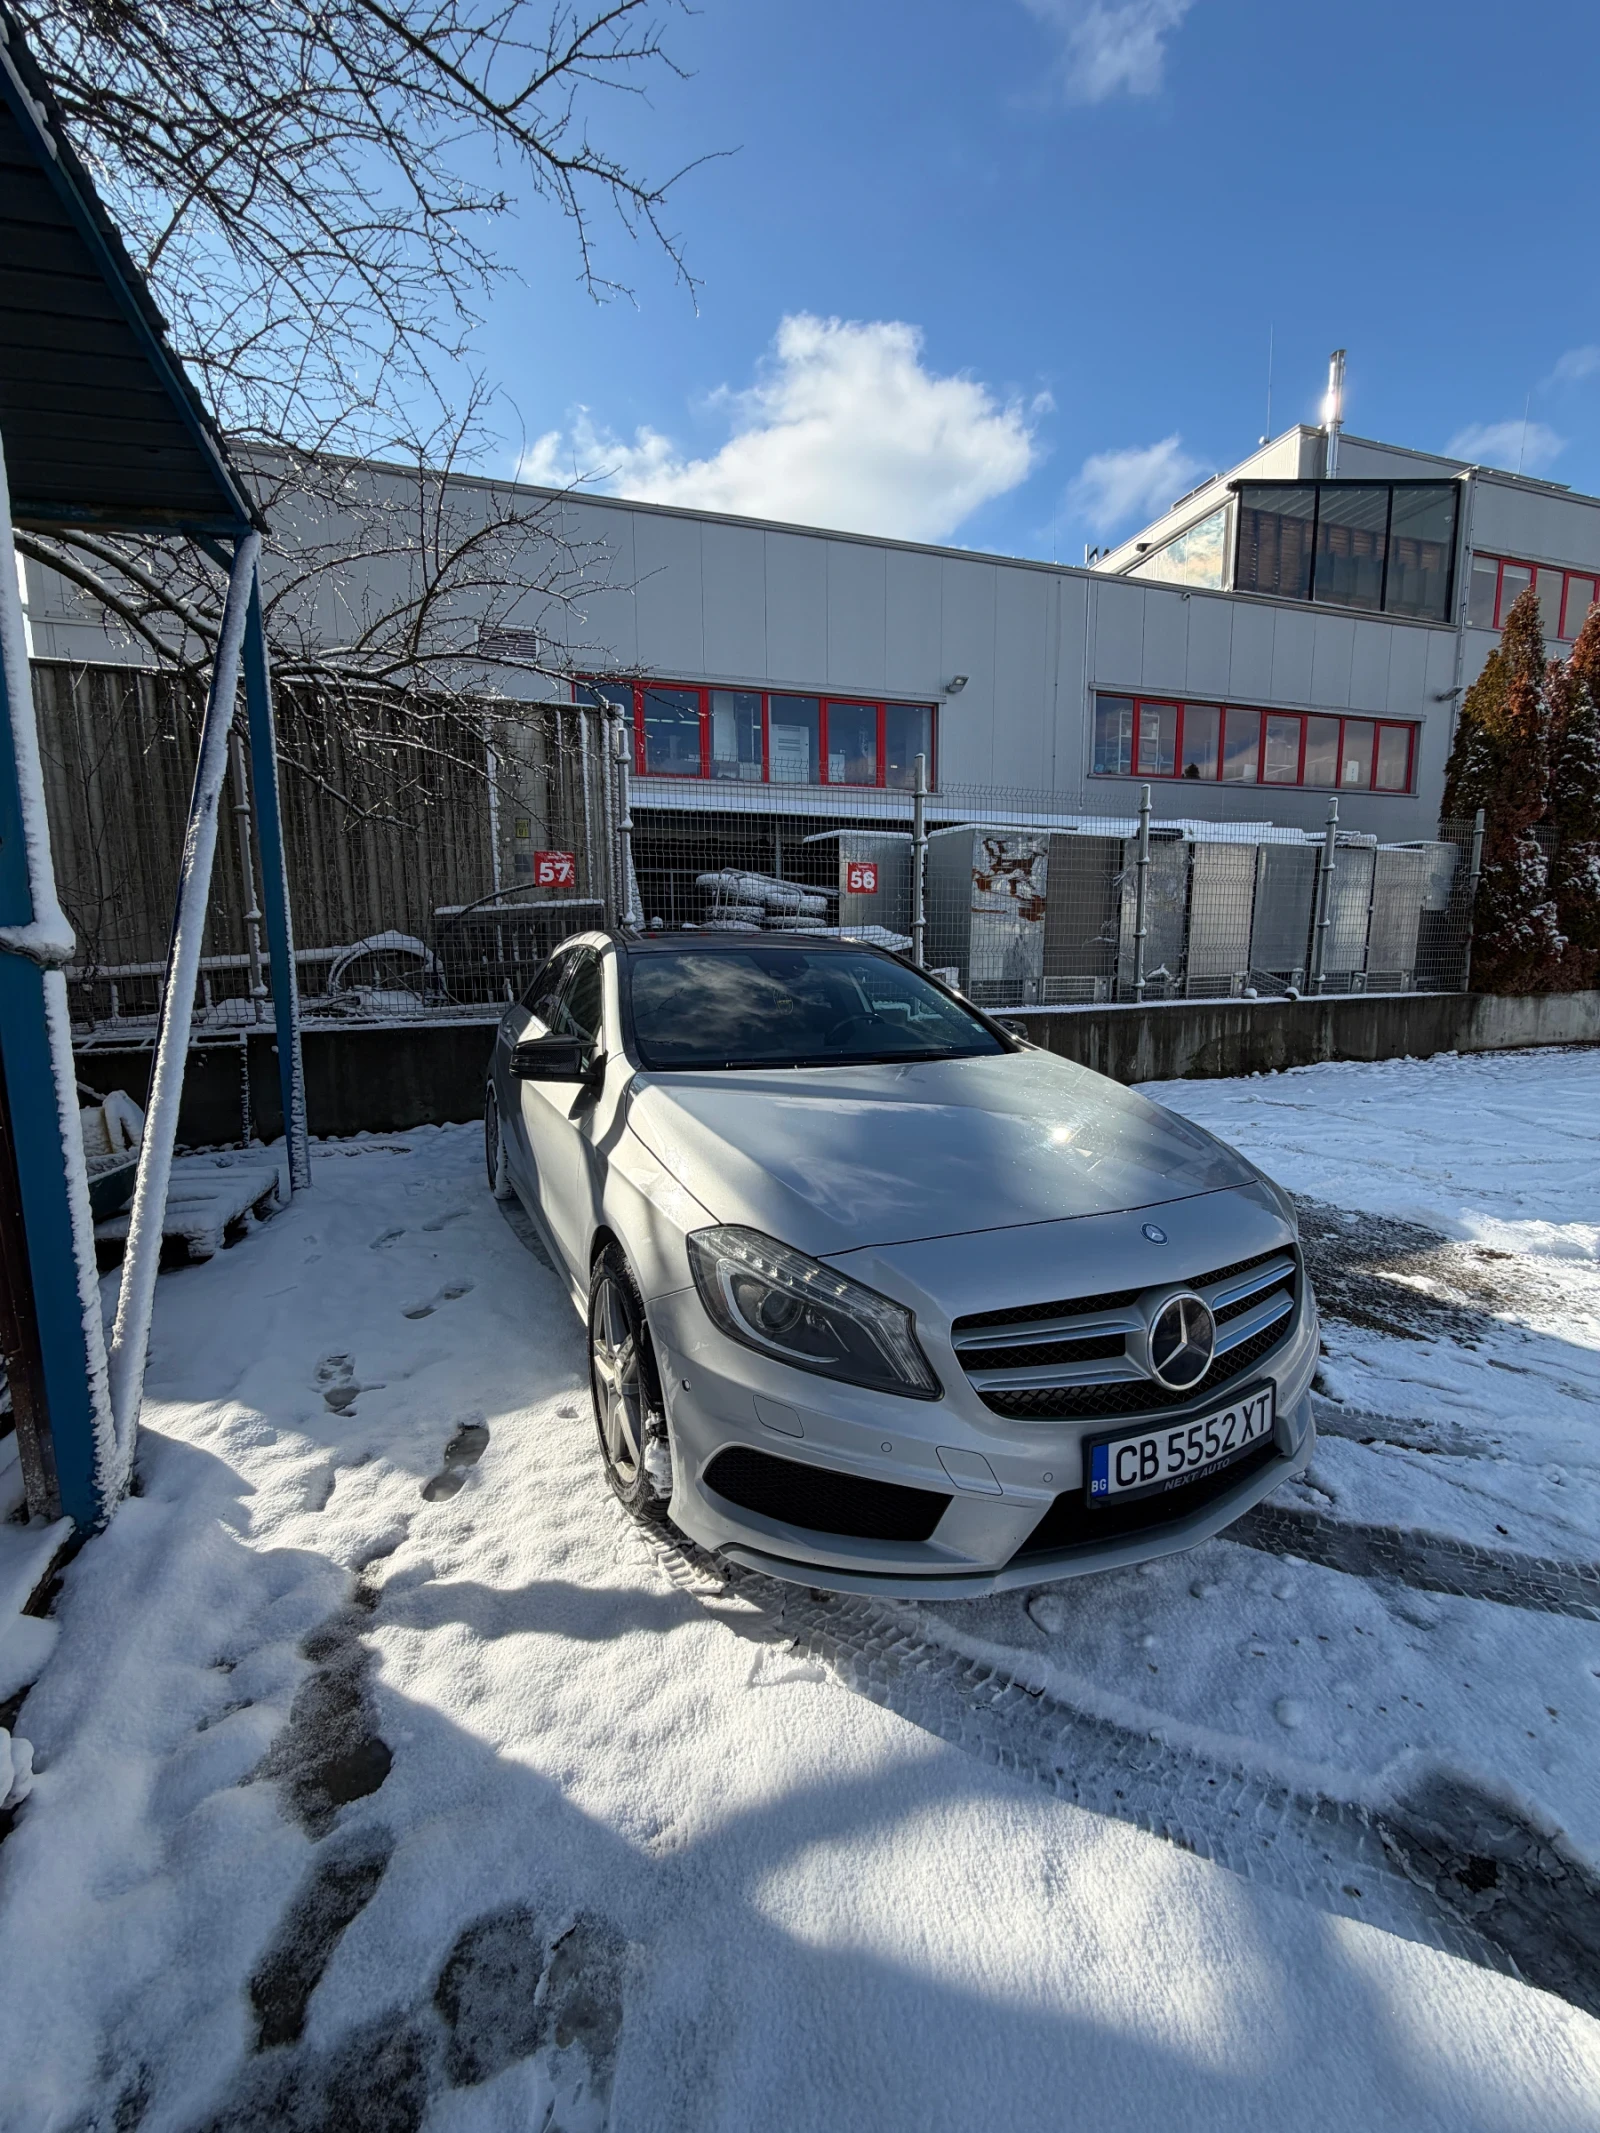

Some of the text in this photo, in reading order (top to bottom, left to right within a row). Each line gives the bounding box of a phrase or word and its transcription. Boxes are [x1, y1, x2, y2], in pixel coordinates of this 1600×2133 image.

[540, 862, 570, 882] 57
[1116, 1393, 1270, 1486] CB 5552 XT
[1091, 1479, 1107, 1493] BG
[1164, 1458, 1230, 1491] NEXT AUTO
